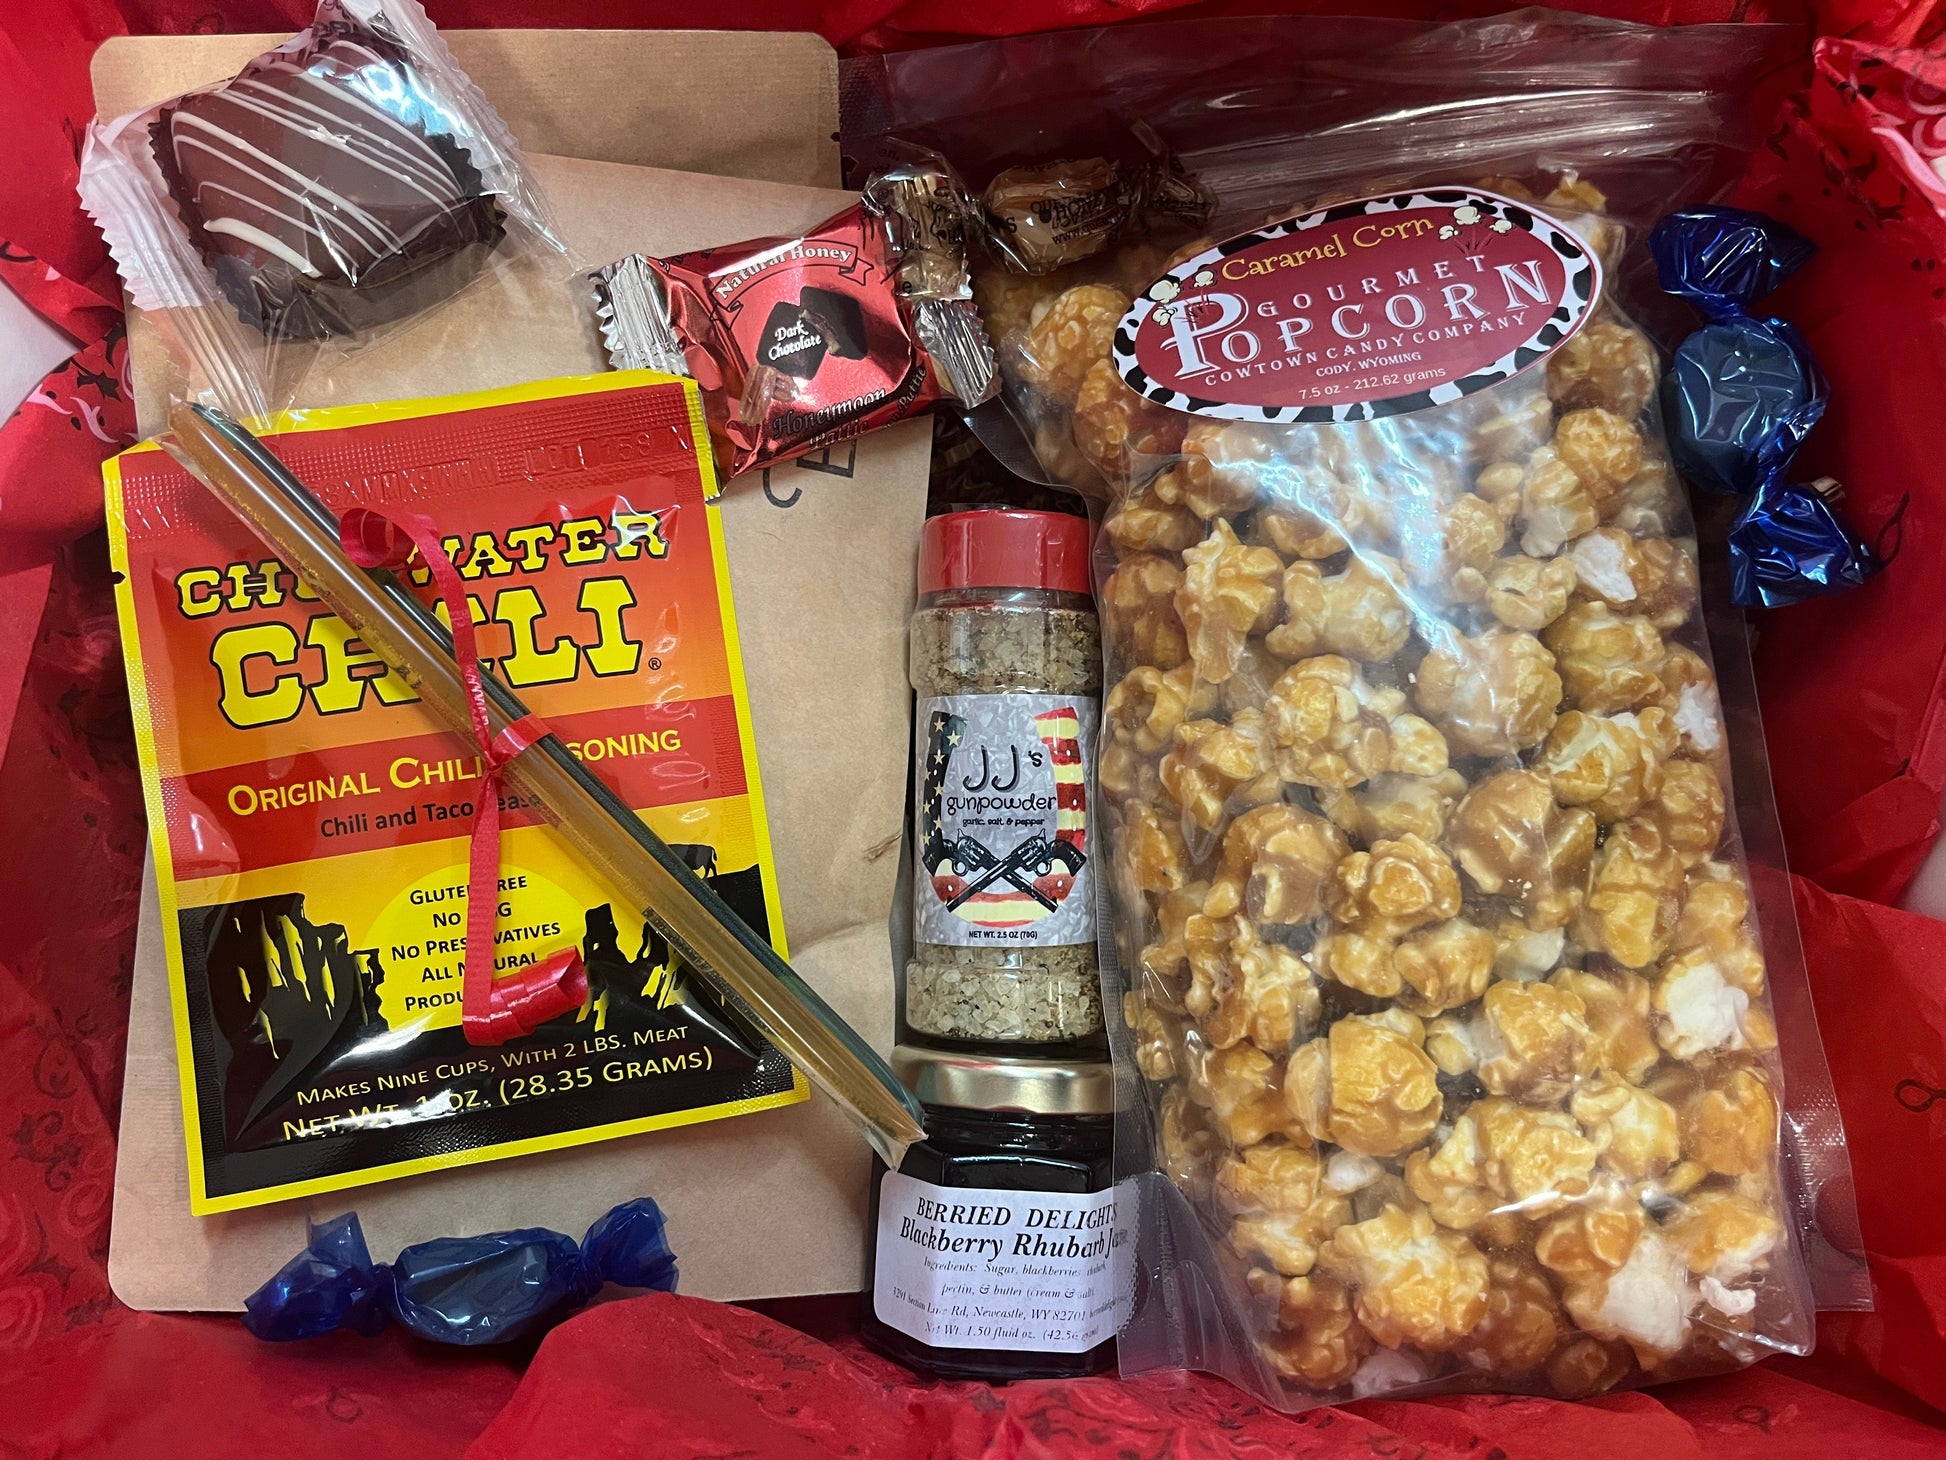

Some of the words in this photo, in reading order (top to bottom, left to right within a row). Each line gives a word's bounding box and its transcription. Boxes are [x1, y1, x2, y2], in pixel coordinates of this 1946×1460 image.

[1221, 240, 1348, 282] Caramel
[1352, 215, 1434, 250] Corn
[715, 252, 786, 299] Natural
[791, 246, 851, 263] Honey
[1257, 255, 1487, 317] GOURMET
[775, 320, 809, 341] Dark
[1160, 260, 1554, 380] POPCORN
[768, 335, 822, 361] Chocolate
[1205, 350, 1318, 386] COWTOWN
[1326, 333, 1405, 361] CANDY
[1412, 312, 1526, 343] COMPANY
[1358, 352, 1422, 370] WYOMING
[1299, 387, 1321, 399] 7.5
[1324, 385, 1341, 395] oz
[1353, 374, 1400, 390] 212.62
[1403, 368, 1446, 384] grams
[773, 388, 886, 439] Honeymoon
[211, 576, 645, 731] CHLI
[227, 770, 381, 817] ORIGINAL
[388, 755, 483, 789] CHILI
[320, 812, 369, 839] Chili
[374, 805, 417, 830] and
[422, 801, 475, 823] Taco
[946, 793, 1057, 816] gunpowder
[1015, 818, 1046, 828] pepper
[410, 885, 470, 906] GLUTE
[497, 876, 528, 892] REE
[426, 922, 561, 956] PRESVATIVES
[969, 931, 982, 939] NET
[984, 931, 995, 939] WT.
[997, 931, 1007, 939] 2.5
[1008, 931, 1019, 939] OZ
[1020, 930, 1038, 940] (70G)
[297, 1081, 371, 1106] MAKES
[377, 1070, 430, 1091] NINE
[501, 1048, 558, 1070] WITH
[565, 1043, 578, 1058] 2
[584, 1034, 627, 1053] LBS.
[633, 1025, 689, 1048] MEAT
[500, 1065, 594, 1106] (28.35
[602, 1045, 715, 1084] GRAMS)
[917, 1197, 1011, 1226] BERRIED
[1025, 1203, 1118, 1230] DELIGHTS
[900, 1216, 1004, 1262] Blackberry
[1012, 1231, 1105, 1259] Rhubarb
[979, 1284, 991, 1295] &
[994, 1285, 1022, 1297] butter
[1064, 1288, 1076, 1298] &
[951, 1305, 969, 1318] Rd,
[1031, 1308, 1050, 1320] WY
[1052, 1310, 1086, 1321] 82701
[967, 1325, 991, 1336] 1.50
[993, 1326, 1019, 1340] fluid
